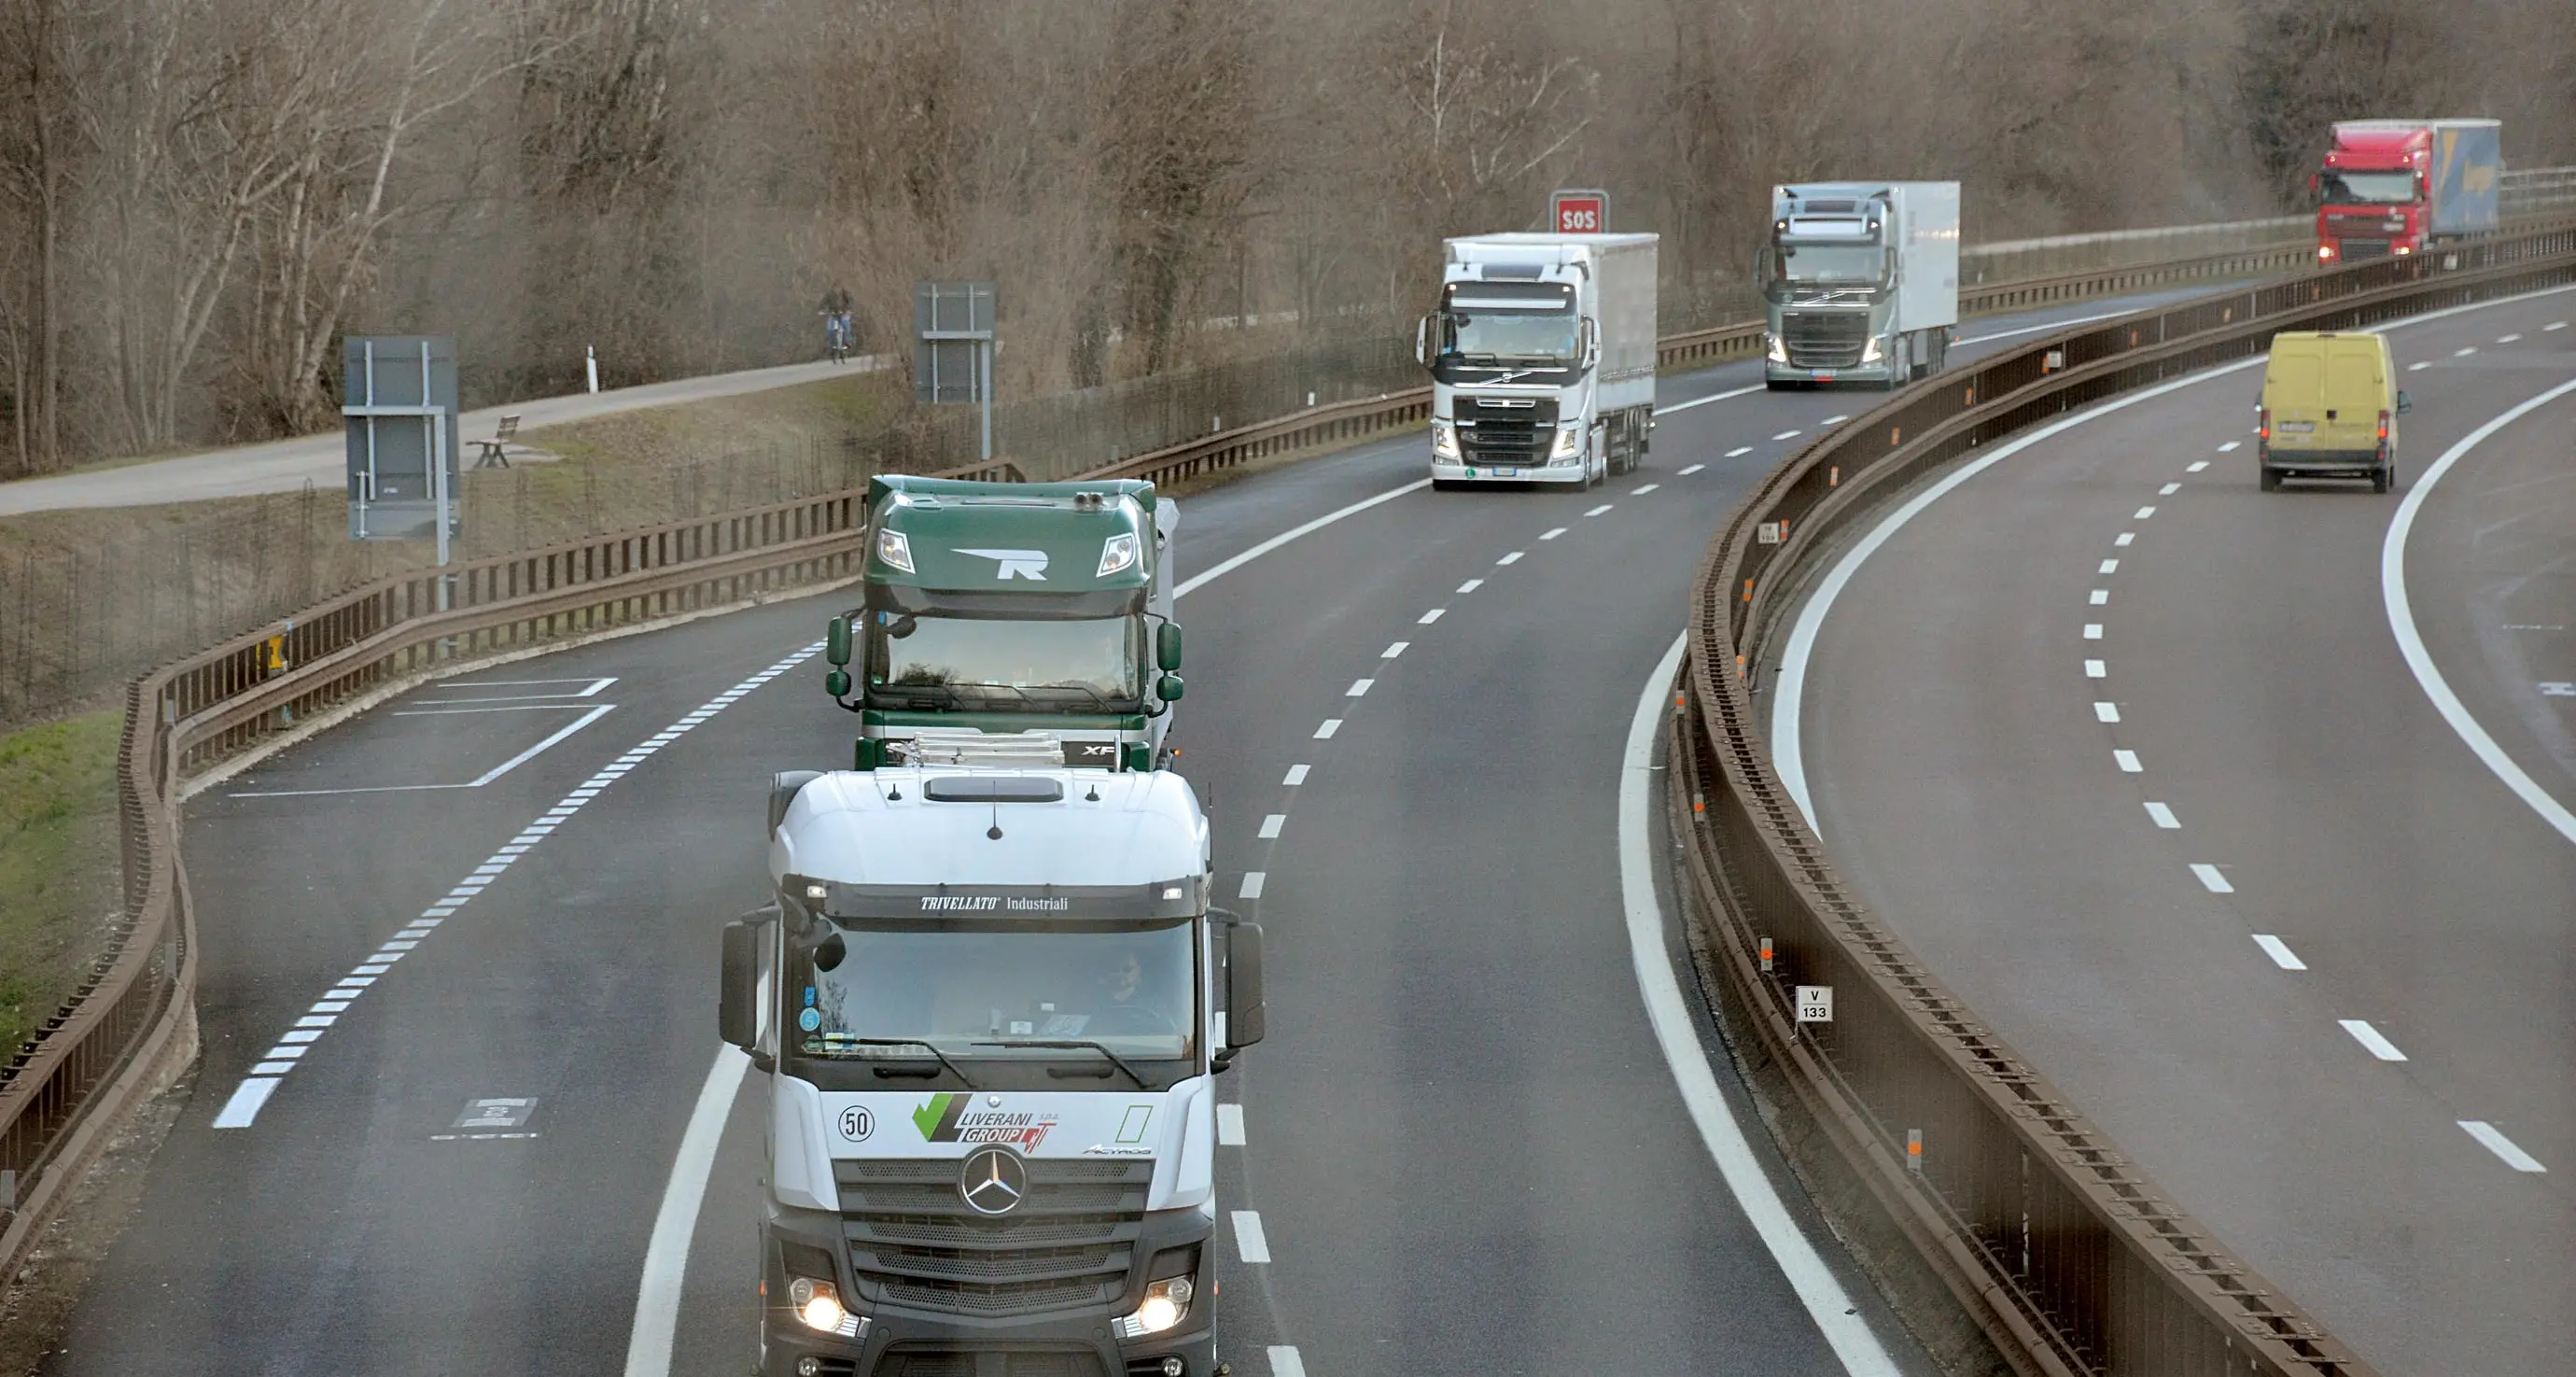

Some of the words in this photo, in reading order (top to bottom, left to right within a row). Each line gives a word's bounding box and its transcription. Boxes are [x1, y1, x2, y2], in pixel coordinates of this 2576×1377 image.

[1562, 210, 1596, 230] SOS
[1083, 746, 1114, 755] XF
[921, 896, 998, 910] TRIVELLATO
[1007, 896, 1068, 910] Industriali
[1811, 991, 1819, 1001] V
[1803, 1007, 1827, 1018] 133
[846, 1112, 867, 1135] 50
[961, 1113, 1033, 1126] LIVERANI
[966, 1129, 1020, 1142] GROUP
